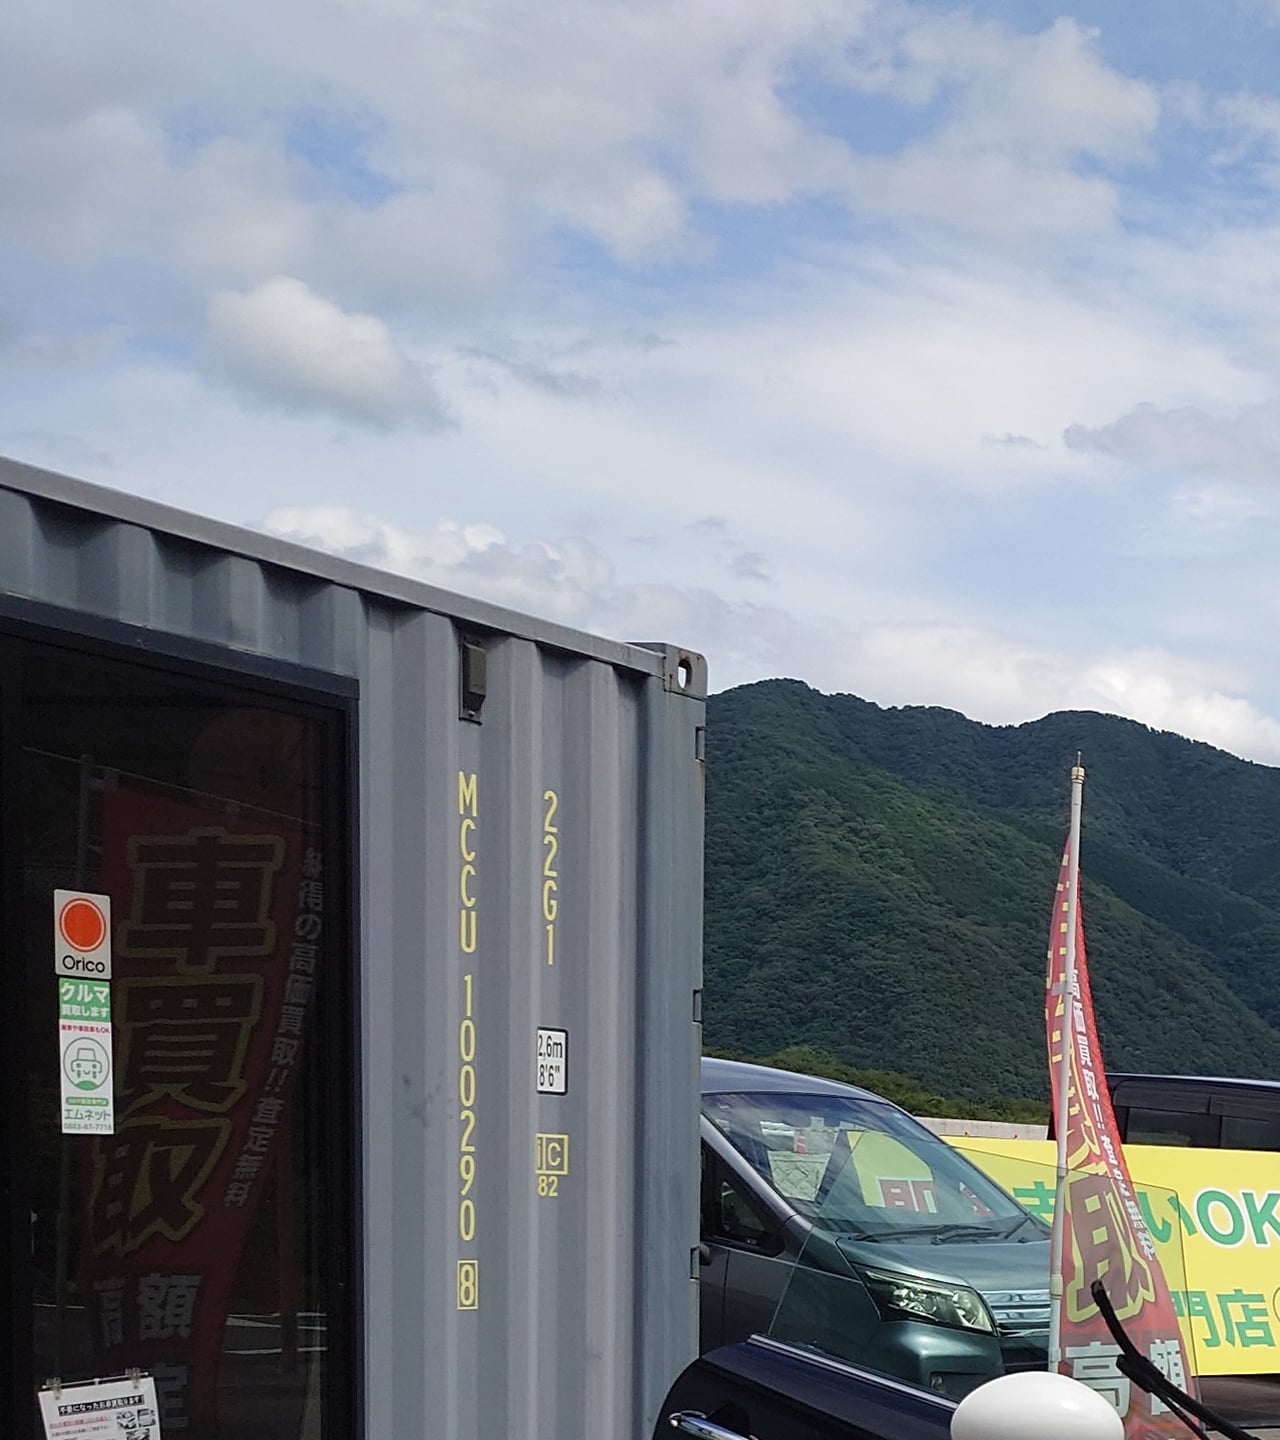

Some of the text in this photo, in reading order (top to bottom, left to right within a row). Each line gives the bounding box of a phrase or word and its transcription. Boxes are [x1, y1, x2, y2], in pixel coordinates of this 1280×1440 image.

[543, 791, 558, 965] 22G1
[62, 955, 105, 973] Orico
[60, 982, 110, 1003] クルマ
[458, 772, 477, 1305] MCCU 100290 8
[64, 1108, 111, 1121] エムネット
[538, 1176, 559, 1197] 82
